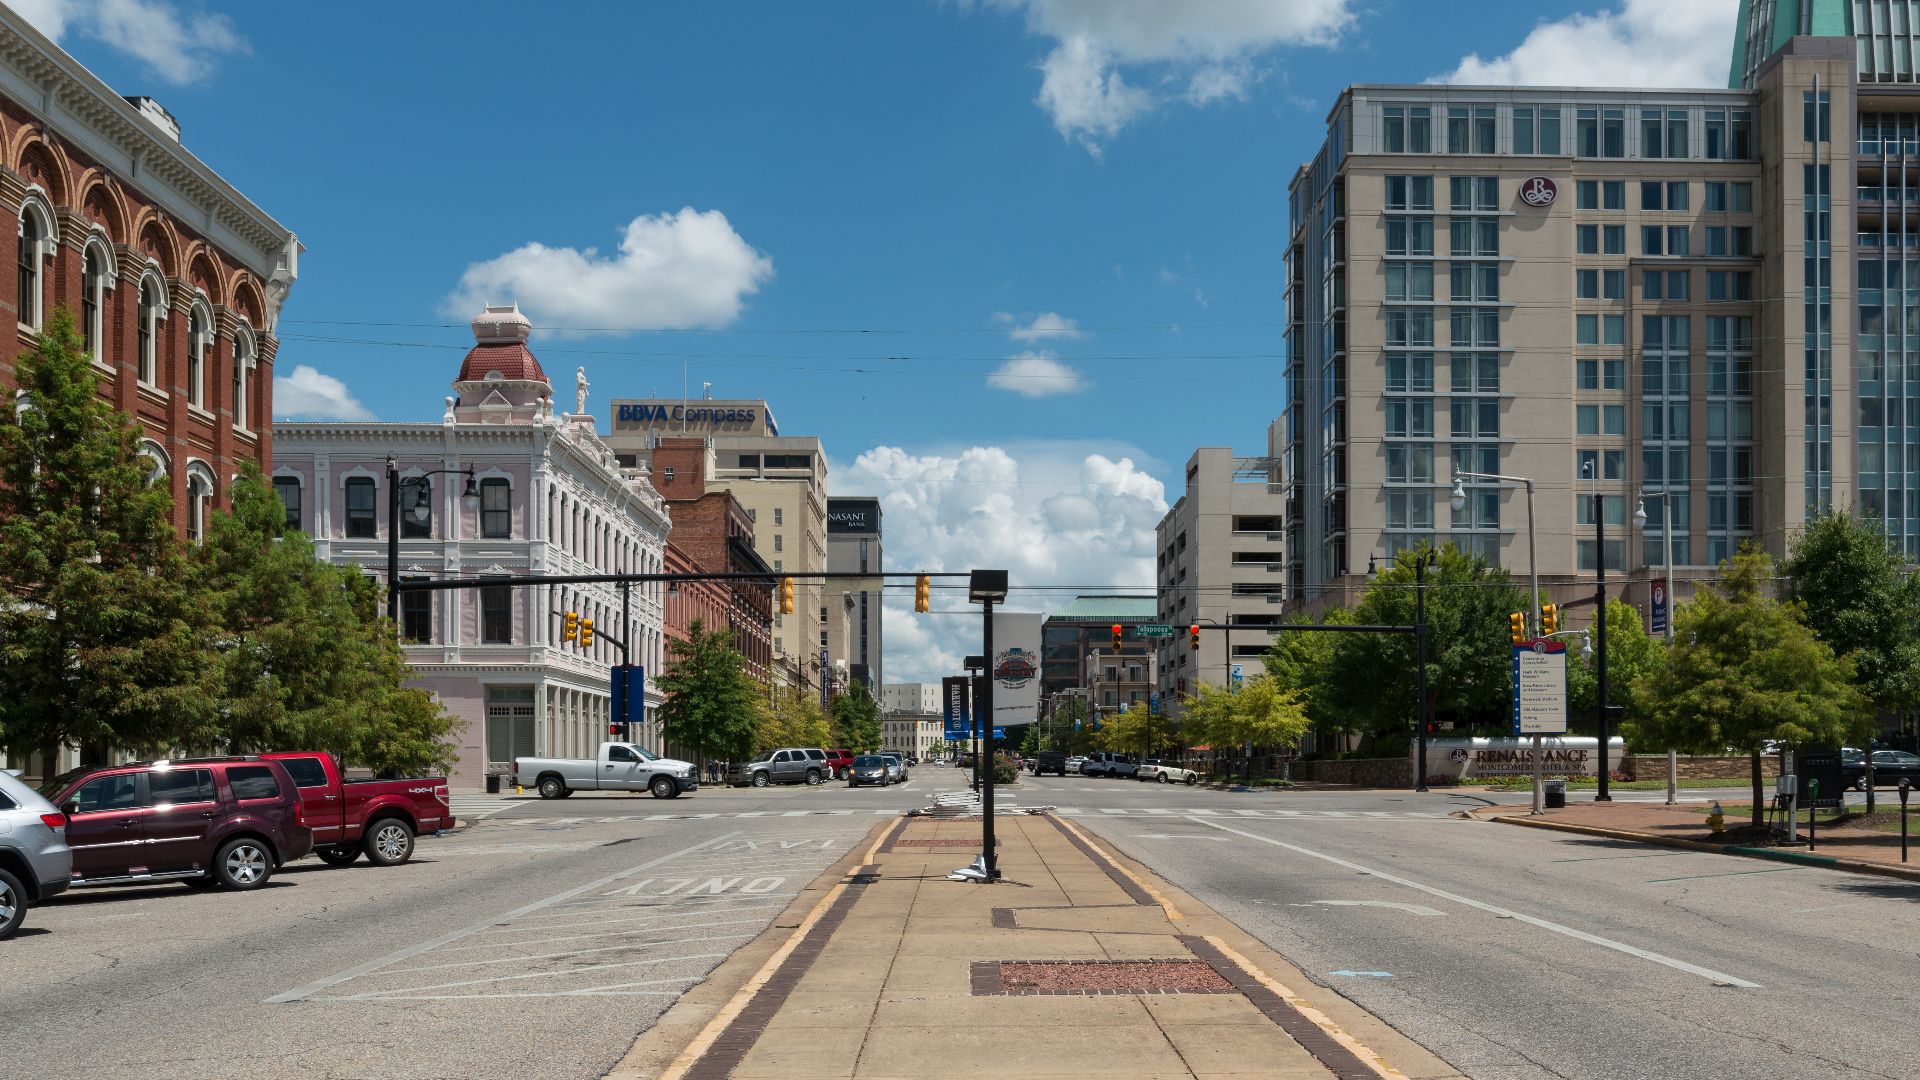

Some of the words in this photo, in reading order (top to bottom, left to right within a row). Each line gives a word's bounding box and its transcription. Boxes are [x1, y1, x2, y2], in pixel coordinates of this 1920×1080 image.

[619, 405, 668, 421] BBVA
[672, 405, 756, 424] Compass
[1136, 626, 1168, 634] Tallapoosa
[1476, 750, 1588, 762] RENAISANCE
[600, 876, 786, 895] ONLY
